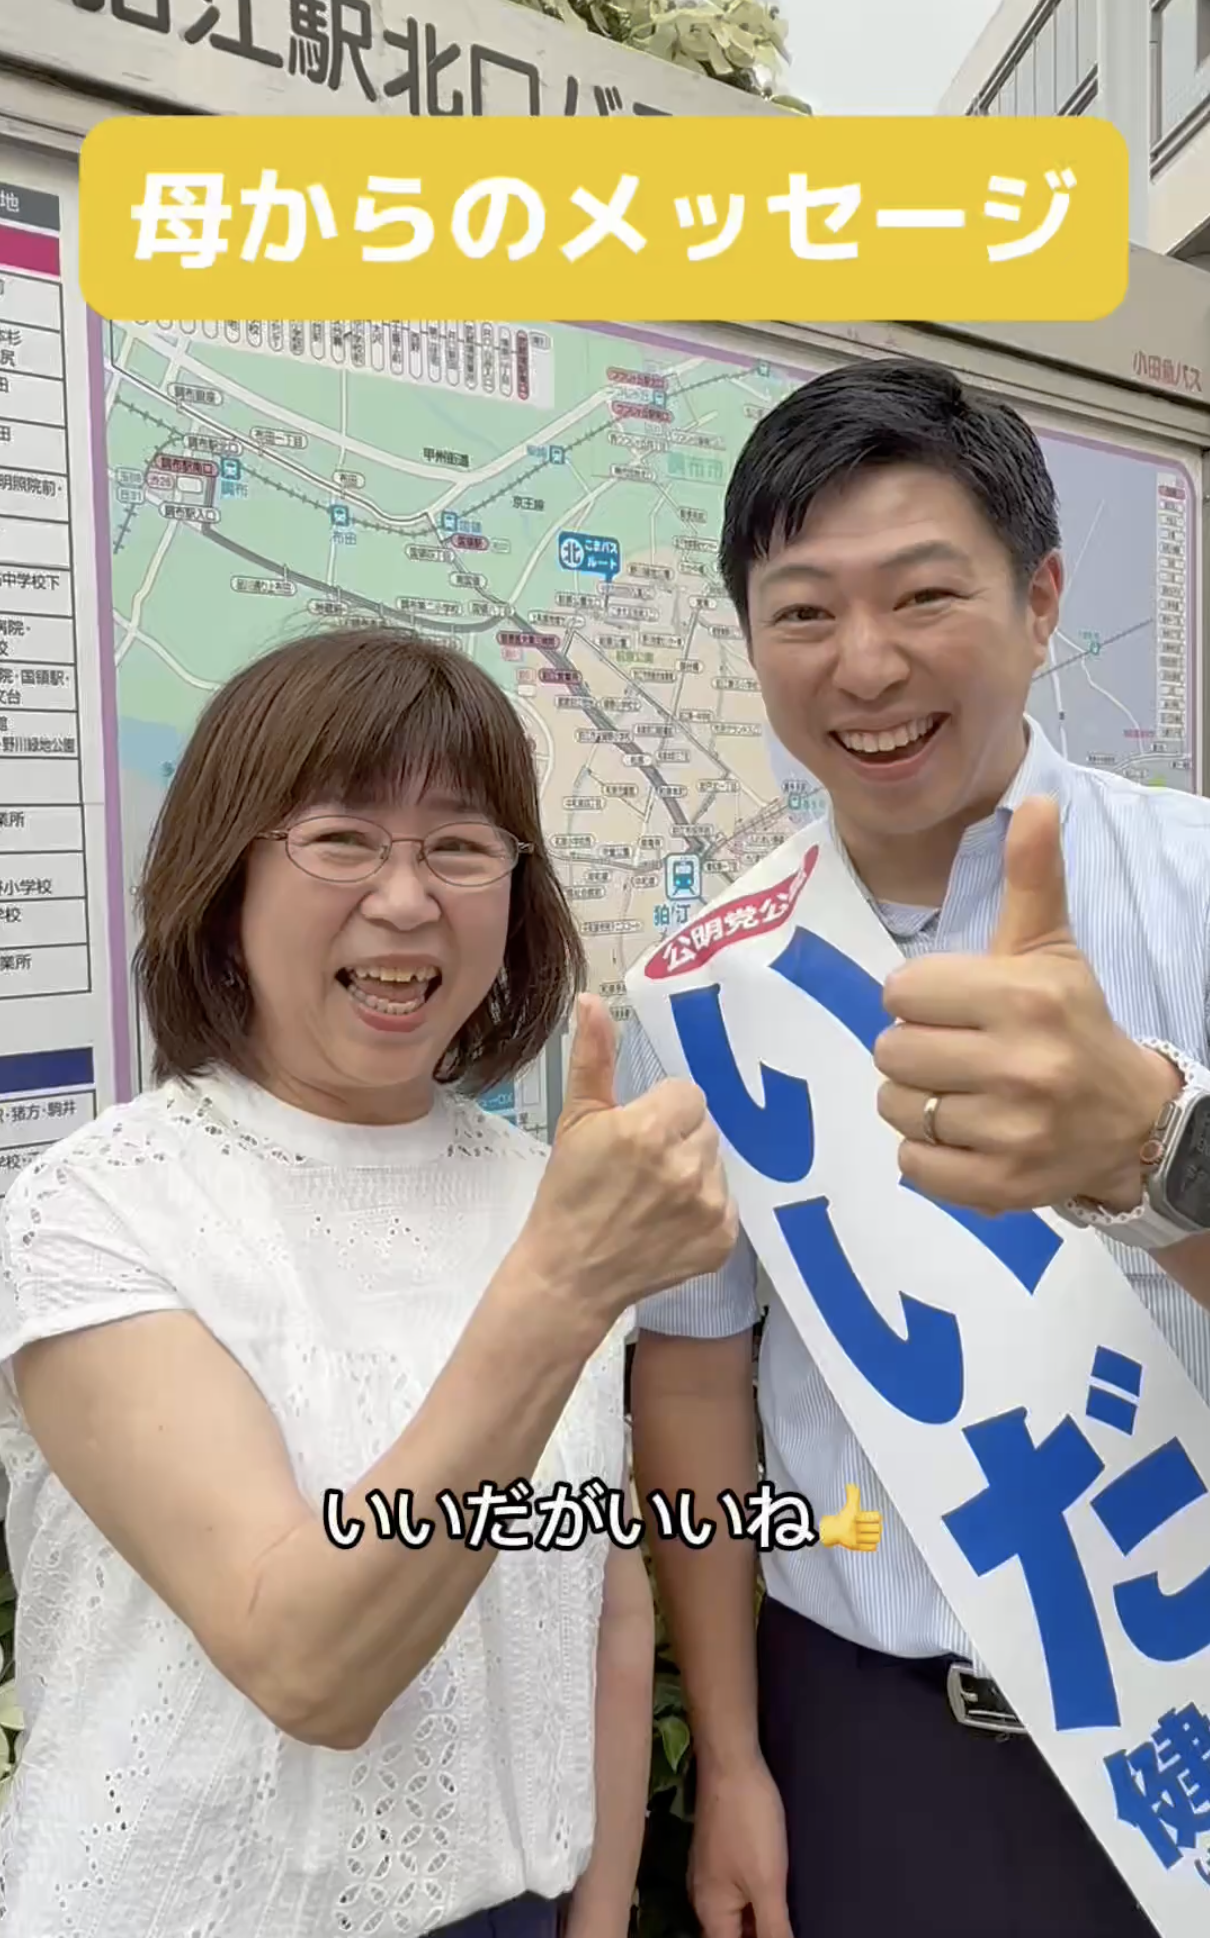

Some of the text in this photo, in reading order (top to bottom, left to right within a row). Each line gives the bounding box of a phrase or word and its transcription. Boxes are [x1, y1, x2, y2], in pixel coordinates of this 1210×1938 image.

[1132, 350, 1203, 393] 小田急バス
[422, 446, 470, 468] 甲州街道
[220, 482, 249, 499] 調布
[164, 505, 217, 520] 調布駅入口
[512, 495, 544, 512] 京王線
[332, 530, 358, 546] 布田
[585, 540, 619, 555] こまバス
[563, 541, 583, 565] 北
[587, 556, 619, 571] ルート
[0, 571, 60, 591] 中学校下
[0, 878, 53, 896] 小学校
[653, 903, 691, 928] 狛江
[664, 866, 808, 972] 公明党公
[0, 1100, 77, 1124] ・猪方・駒井
[669, 926, 1210, 1732] いいだ
